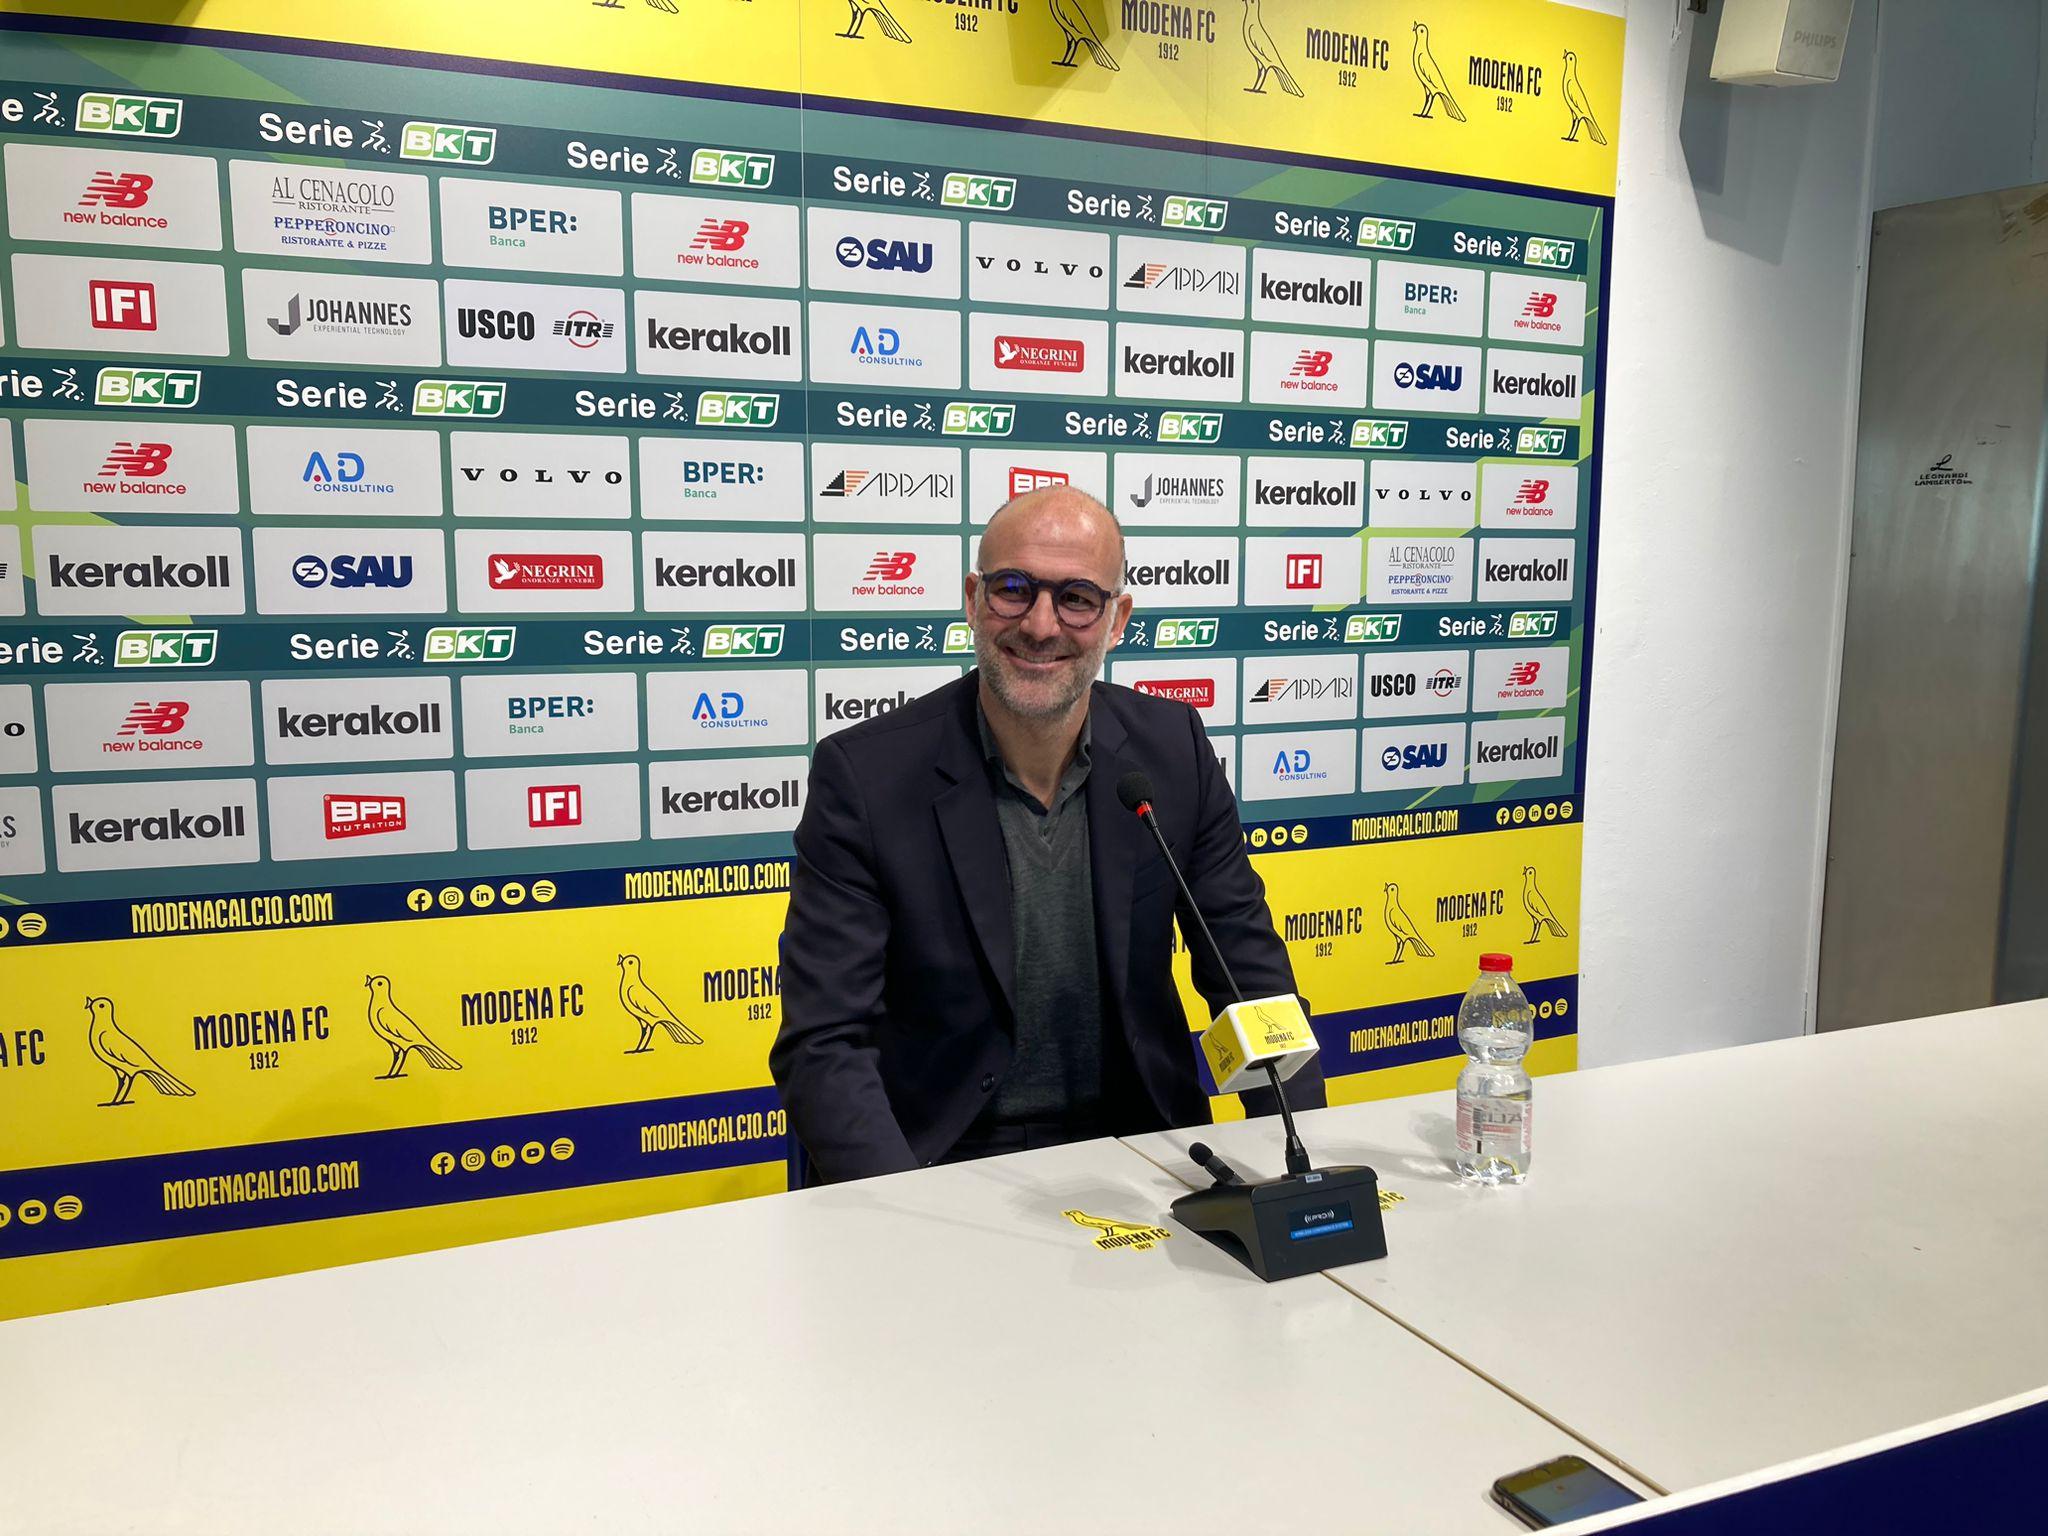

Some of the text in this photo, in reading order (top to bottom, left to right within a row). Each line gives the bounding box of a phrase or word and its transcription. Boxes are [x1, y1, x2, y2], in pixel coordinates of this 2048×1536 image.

[955, 15, 978, 32] 1912
[1122, 0, 1215, 43] MODENA FC
[1306, 27, 1389, 71] MODENA FC
[1793, 30, 1837, 49] PHILIPS
[1158, 42, 1179, 61] 1912
[1338, 70, 1356, 88] 1912
[1469, 55, 1541, 96] MODENA FC
[83, 104, 176, 127] BKT
[1496, 96, 1512, 113] 1912
[259, 112, 490, 156] Serie BKT
[567, 142, 649, 175] Serie
[272, 176, 394, 207] AL CENACOLO
[833, 166, 1011, 204] Serie BKT
[298, 201, 371, 214] RISTORANTE
[1067, 189, 1131, 218] Serie
[64, 210, 168, 229] new balance
[274, 216, 391, 236] PEPPERONCINO
[1275, 211, 1329, 239] Serie
[281, 235, 387, 251] RISTORANTE & PIZZE
[489, 235, 526, 248] Banca
[1454, 232, 1572, 264] Serie BKT
[677, 253, 759, 269] new balance
[867, 238, 933, 273] SAU
[976, 256, 1103, 278] VOLVO
[1155, 267, 1239, 295] APPARI
[1261, 272, 1362, 306] kerakoll
[95, 288, 151, 324] IFI
[306, 299, 412, 326] JOHANNES
[1404, 305, 1426, 315] Banca
[313, 324, 406, 336] EXPERIENTIAL TECHNOLOGY
[457, 308, 534, 341] USCO
[565, 321, 603, 339] ITR
[1514, 320, 1561, 332] new balance
[648, 318, 790, 356] kerakoll
[859, 356, 922, 366] CONSULTING
[1020, 346, 1077, 361] NEGRINI
[1124, 346, 1234, 378] kerakoll
[101, 376, 195, 399] BKT
[1281, 380, 1338, 392] new balance
[1415, 363, 1462, 391] SAU
[1493, 369, 1576, 398] kerakoll
[276, 379, 367, 409] Serie
[837, 401, 907, 428] Serie
[1162, 419, 1215, 438] BKT
[1269, 420, 1323, 443] Serie
[1446, 427, 1493, 450] Serie
[460, 467, 623, 485] VOLVO
[857, 473, 953, 498] APPARI
[1156, 477, 1224, 497] JOHANNES
[83, 481, 186, 495] new balance
[314, 483, 393, 494] CONSULTING
[684, 488, 717, 499] Banca
[1255, 480, 1356, 506] kerakoll
[1376, 488, 1471, 501] VOLVO
[1506, 506, 1553, 517] new balance
[1389, 546, 1455, 562] AL CENACOLO
[49, 555, 229, 588] kerakoll
[330, 555, 413, 587] SAU
[522, 565, 594, 577] NEGRINI
[655, 557, 795, 587] kerakoll
[1124, 559, 1229, 585] kerakoll
[1288, 560, 1320, 584] IFI
[1388, 575, 1451, 584] PEPPERONCINO
[1485, 558, 1567, 582] kerakoll
[852, 584, 924, 595] new balance
[1158, 625, 1215, 642] BKT
[1264, 620, 1318, 642] Serie
[1438, 616, 1485, 636] Serie
[120, 637, 210, 658] BKT
[290, 633, 379, 660] Serie
[584, 631, 664, 655] Serie
[840, 628, 909, 651] Serie
[1157, 687, 1208, 699] NEGRINI
[1277, 677, 1352, 701] APPARI
[1371, 673, 1416, 696] USCO
[1431, 677, 1456, 689] ITR
[1498, 688, 1544, 699] new balance
[278, 703, 441, 738] kerakoll
[509, 723, 544, 734] Banca
[700, 719, 768, 728] CONSULTING
[103, 738, 203, 753] new balance
[1402, 743, 1447, 769] SAU
[1477, 736, 1557, 764] kerakoll
[1279, 772, 1327, 781] CONSULTING
[532, 791, 578, 822] IFI
[661, 780, 799, 814] kerakoll
[330, 801, 401, 820] BPR
[69, 806, 245, 844] kerakoll
[332, 820, 401, 833] NUTRITION
[1352, 809, 1458, 841] MODENACALCIO.COM
[625, 861, 790, 900] MODENACALCIO.COM
[131, 893, 333, 933] MODENACALCIO.COM
[1436, 890, 1504, 923] MODENA FC
[1285, 907, 1362, 942] MODENA FC
[1462, 924, 1477, 938] 1912
[1315, 943, 1332, 958] 1912
[461, 983, 583, 1026] MODENA FC
[747, 1003, 771, 1021] 1912
[193, 1005, 328, 1050] MODENA FC
[511, 1027, 537, 1045] 1912
[1265, 1031, 1294, 1045] MODENA FC
[1350, 1015, 1454, 1053] MODENACALCIO.COM
[15, 1029, 45, 1066] FC
[250, 1051, 279, 1070] 1912
[163, 1160, 359, 1211] MODENACALCIO.COM
[1096, 1228, 1171, 1250] MODENA FC
